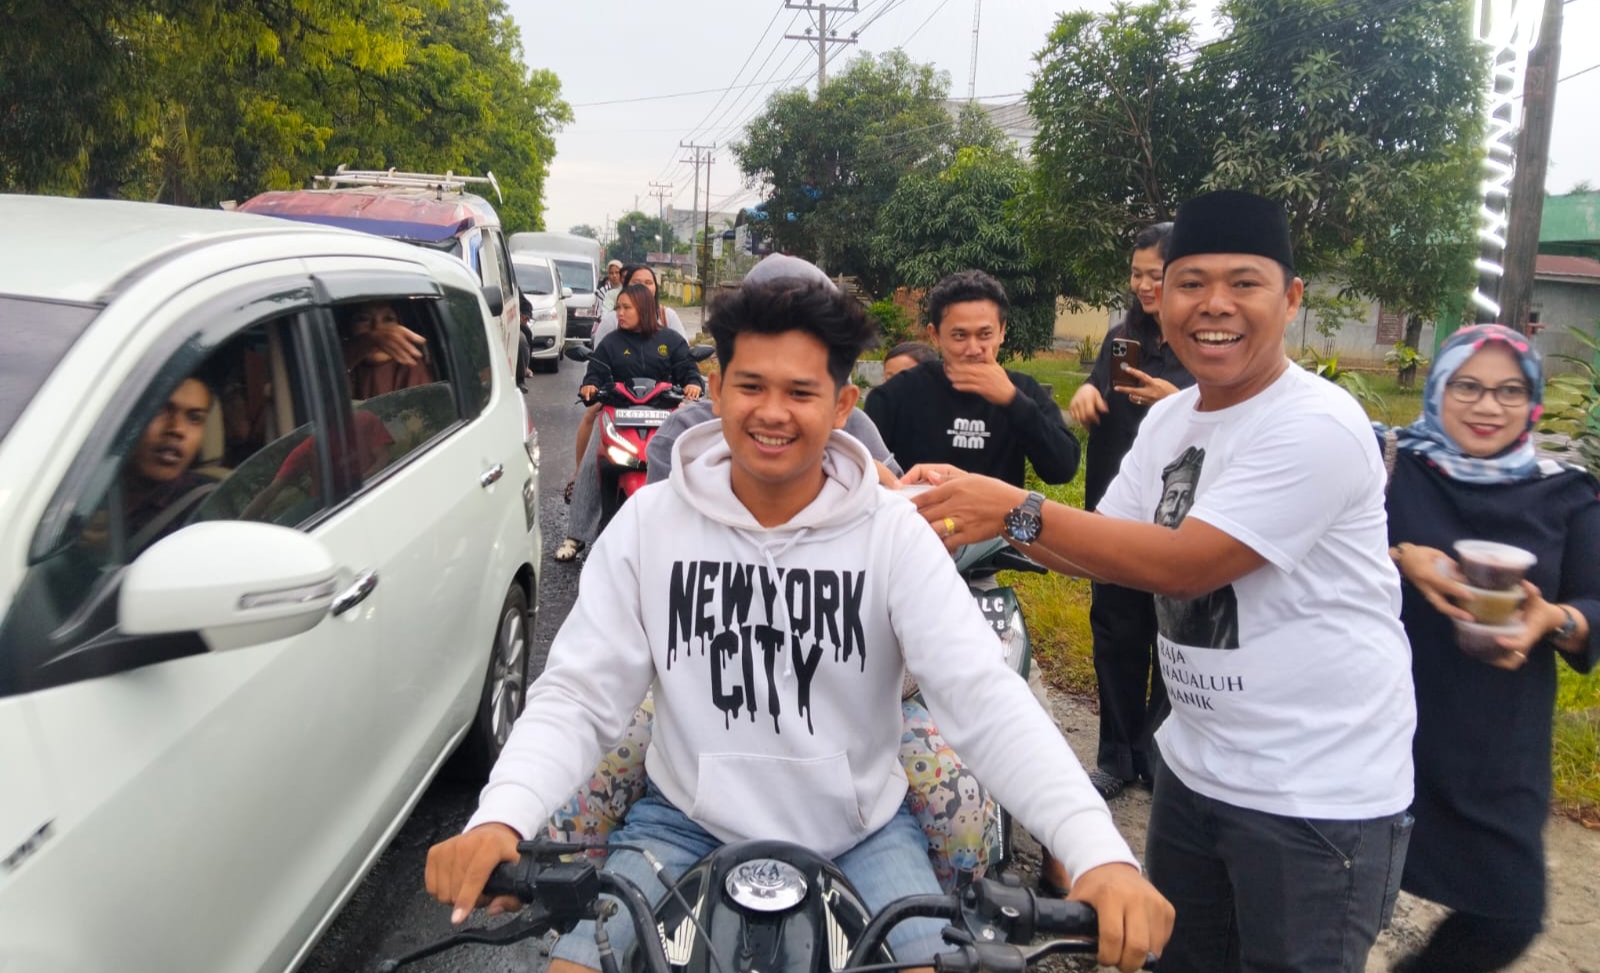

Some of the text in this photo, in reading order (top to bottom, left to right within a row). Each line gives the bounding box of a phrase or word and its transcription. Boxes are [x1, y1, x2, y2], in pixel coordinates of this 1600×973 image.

[1160, 640, 1186, 664] RAJA
[710, 623, 824, 736] CITY
[1162, 664, 1244, 692] NAUALUH
